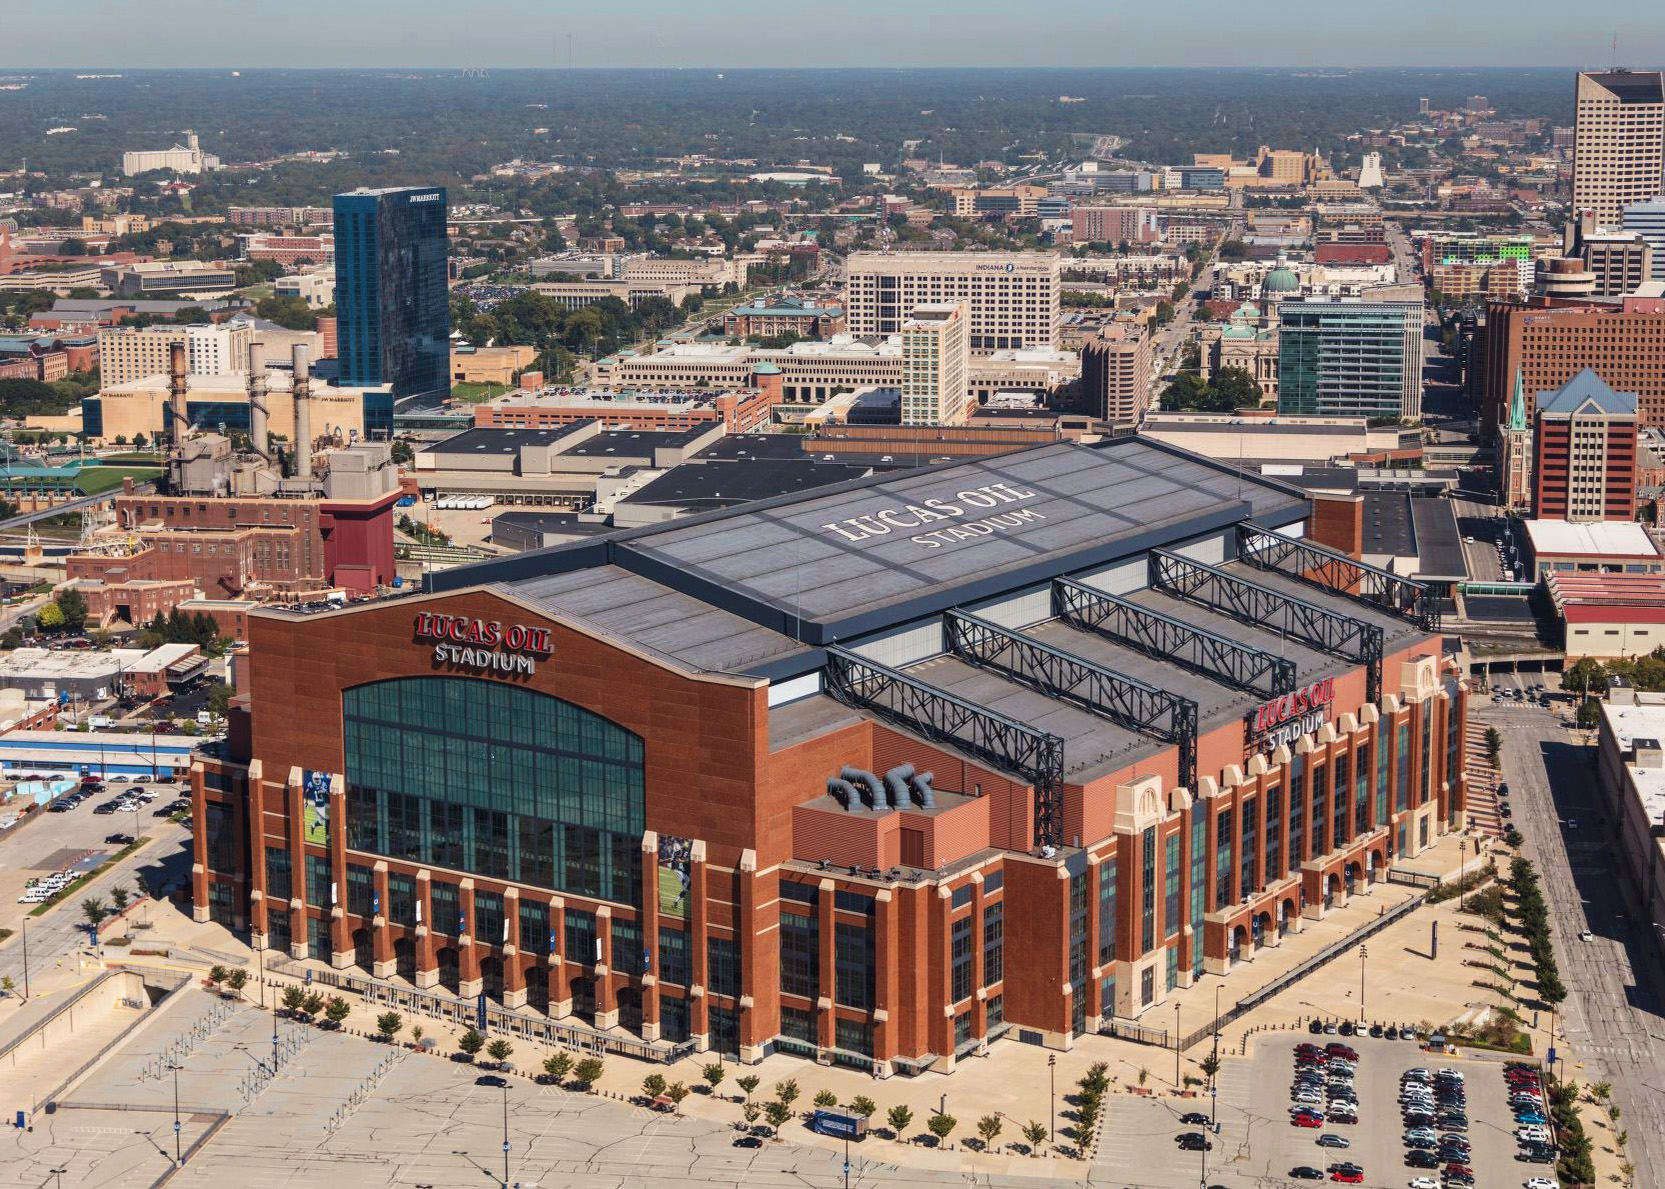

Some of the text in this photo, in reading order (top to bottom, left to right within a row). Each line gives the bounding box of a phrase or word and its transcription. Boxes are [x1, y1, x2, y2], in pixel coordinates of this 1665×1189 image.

[417, 193, 440, 202] MARRIOTT
[821, 483, 1037, 542] LUCAS OIL
[909, 508, 1047, 549] STADIUM
[415, 611, 555, 654] LUCAS OIL
[435, 643, 536, 675] STADIUM
[1254, 677, 1335, 732] LUCAS OIL
[1269, 711, 1324, 751] STADIUM
